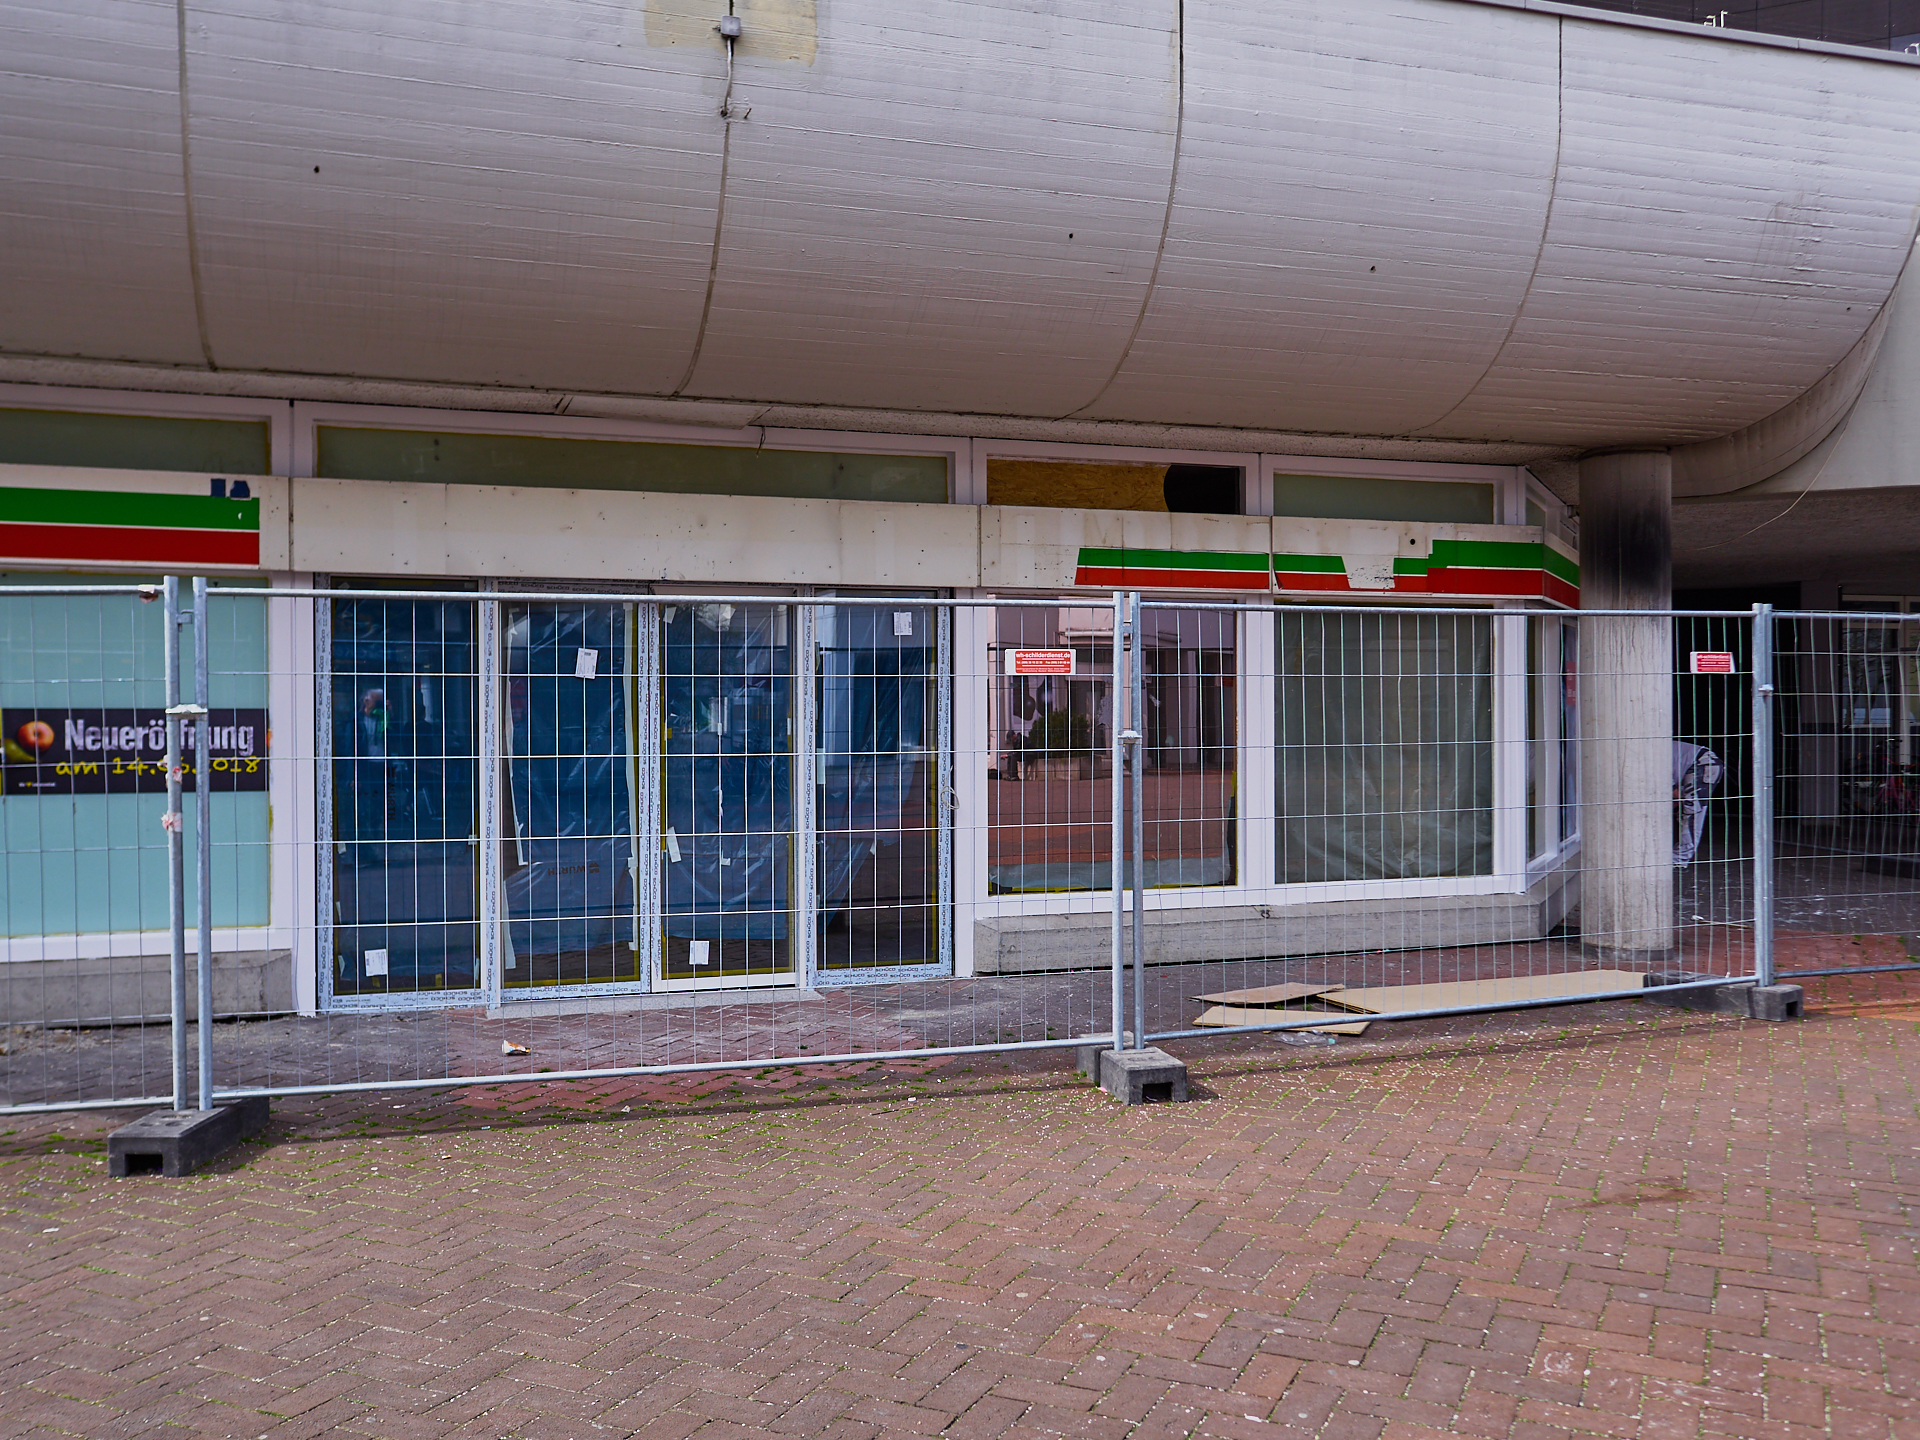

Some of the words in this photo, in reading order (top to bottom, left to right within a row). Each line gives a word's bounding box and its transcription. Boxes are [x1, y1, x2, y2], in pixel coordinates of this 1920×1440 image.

[64, 718, 254, 756] Neueröfung
[56, 760, 98, 776] am
[112, 756, 260, 776] 14.6.018
